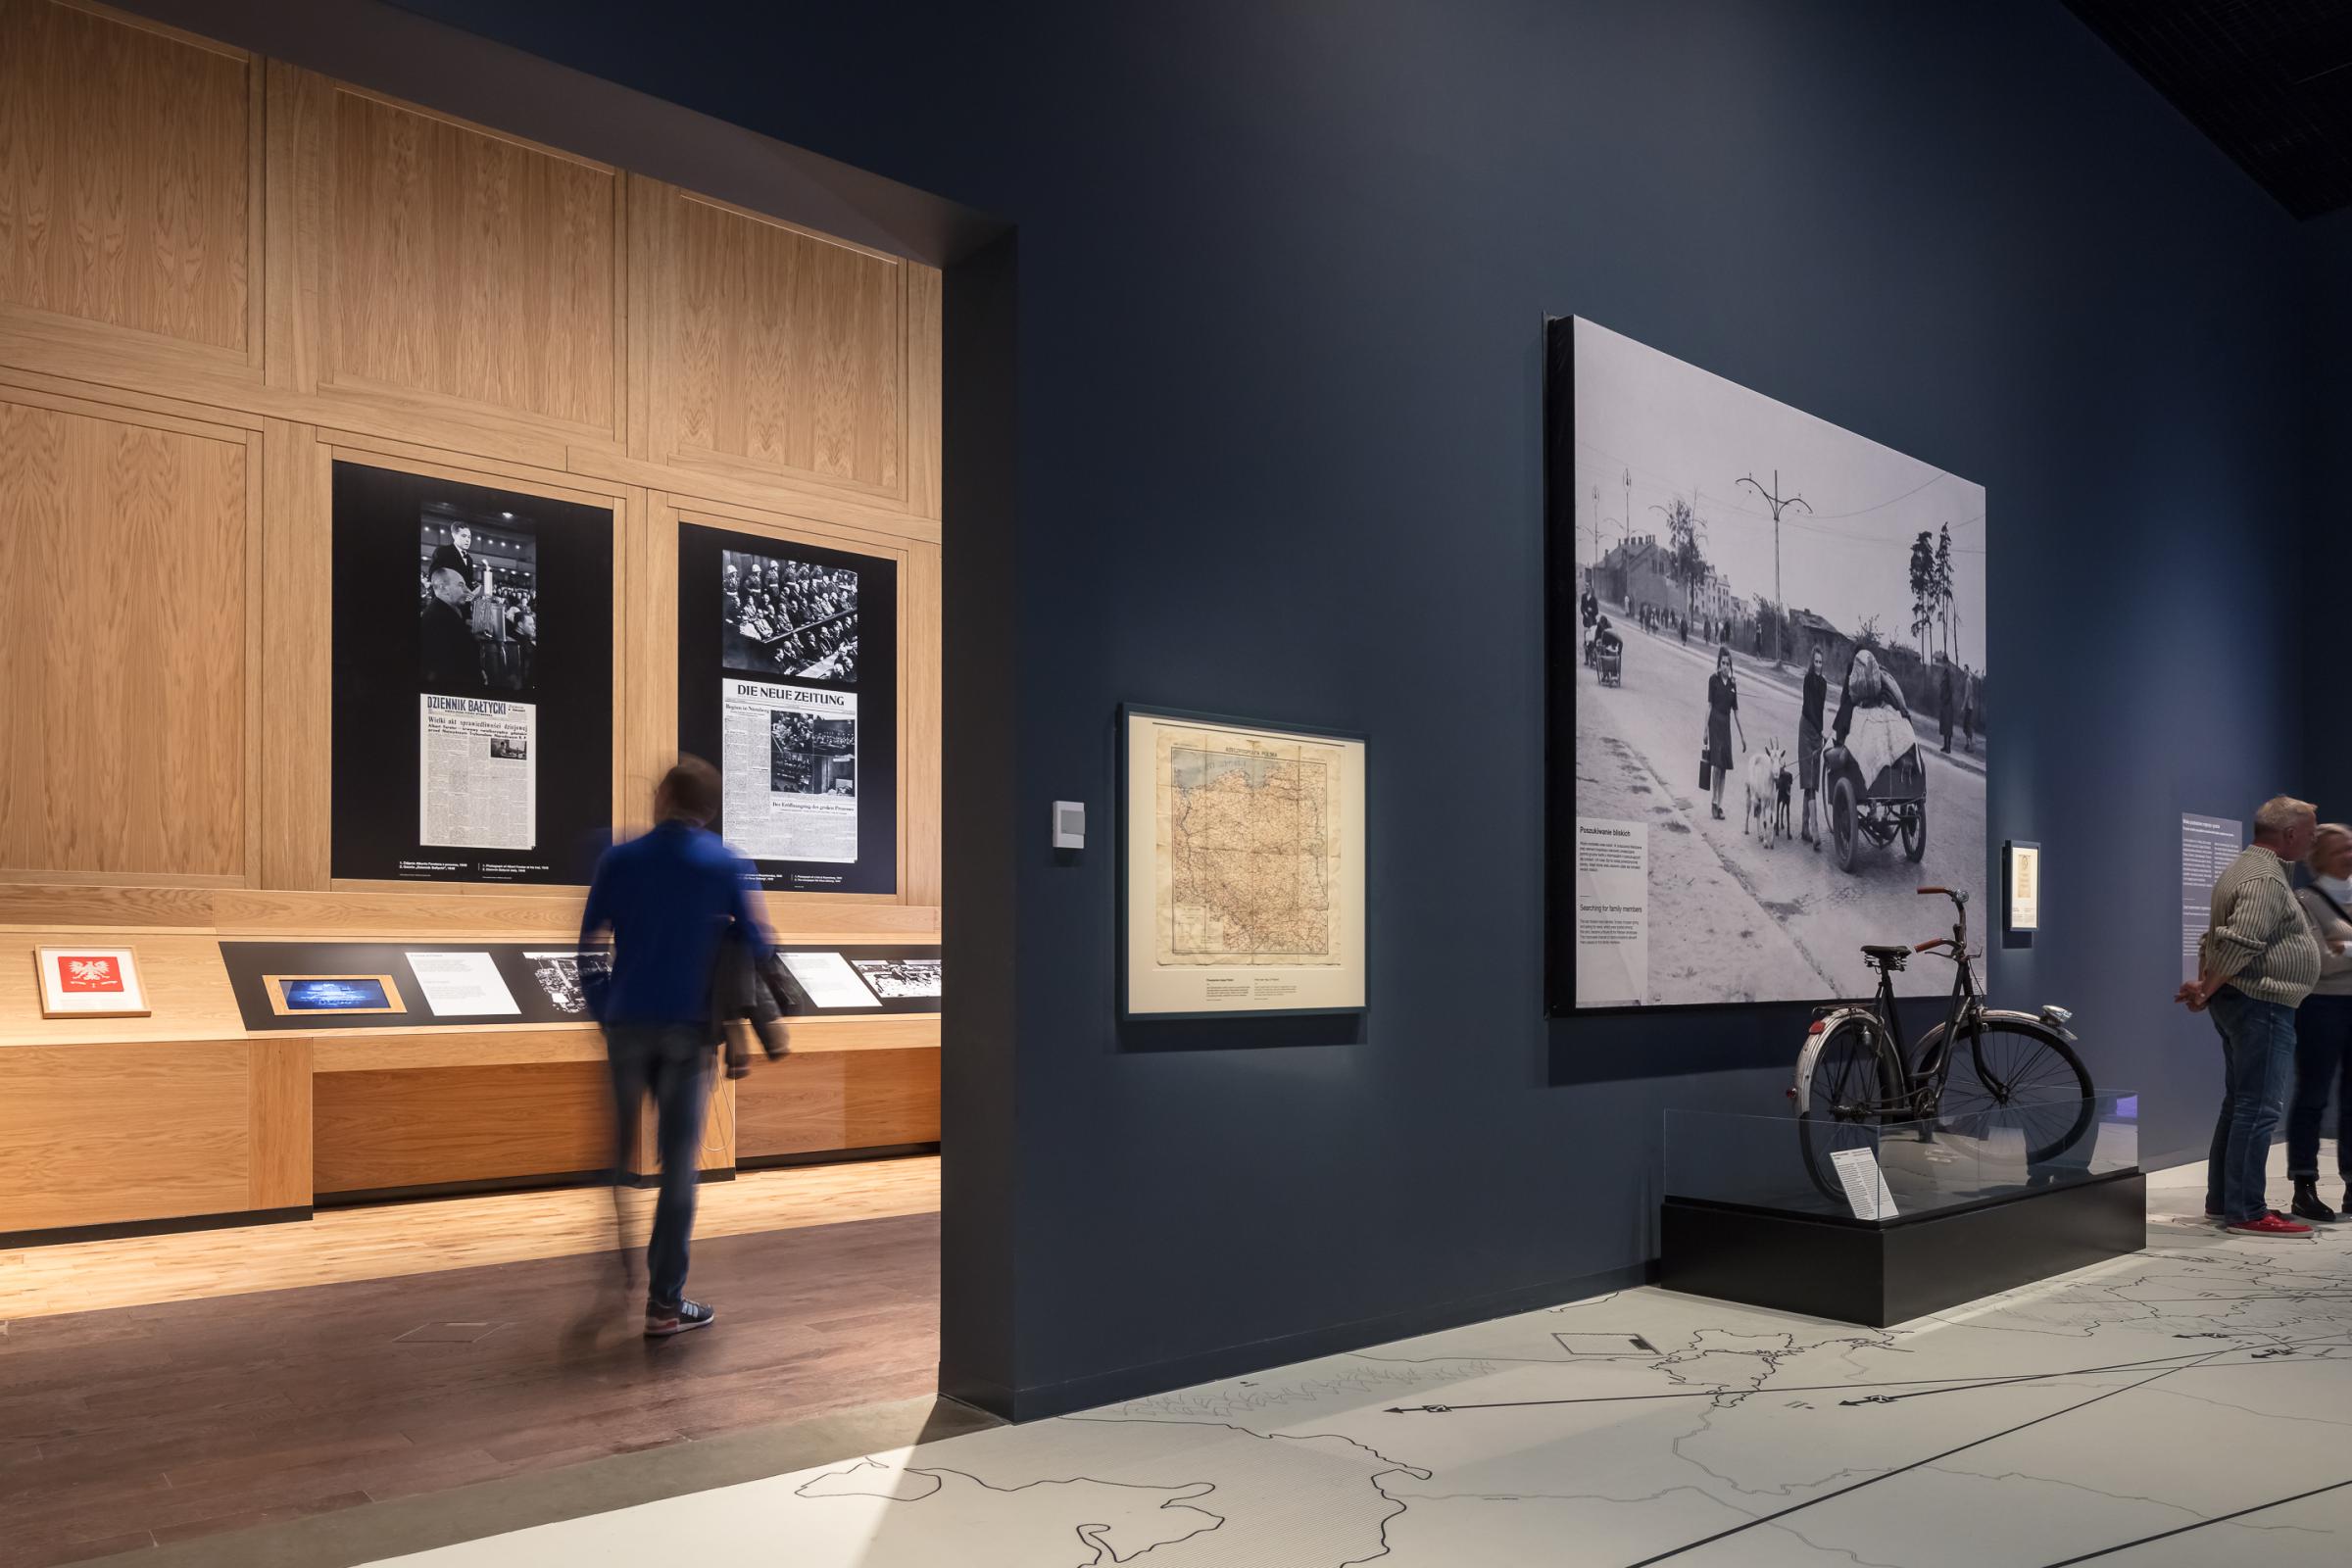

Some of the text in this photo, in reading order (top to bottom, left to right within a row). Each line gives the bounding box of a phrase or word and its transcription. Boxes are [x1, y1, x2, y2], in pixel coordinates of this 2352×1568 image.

[738, 684, 845, 706] DIE NEUE ZEITUNG
[427, 696, 466, 711] DZIENNIK
[468, 700, 507, 715] BAŁTYCKI
[1580, 826, 1612, 835] Poszukiwanie
[1580, 904, 1601, 913] Searching
[1609, 905, 1622, 913] family
